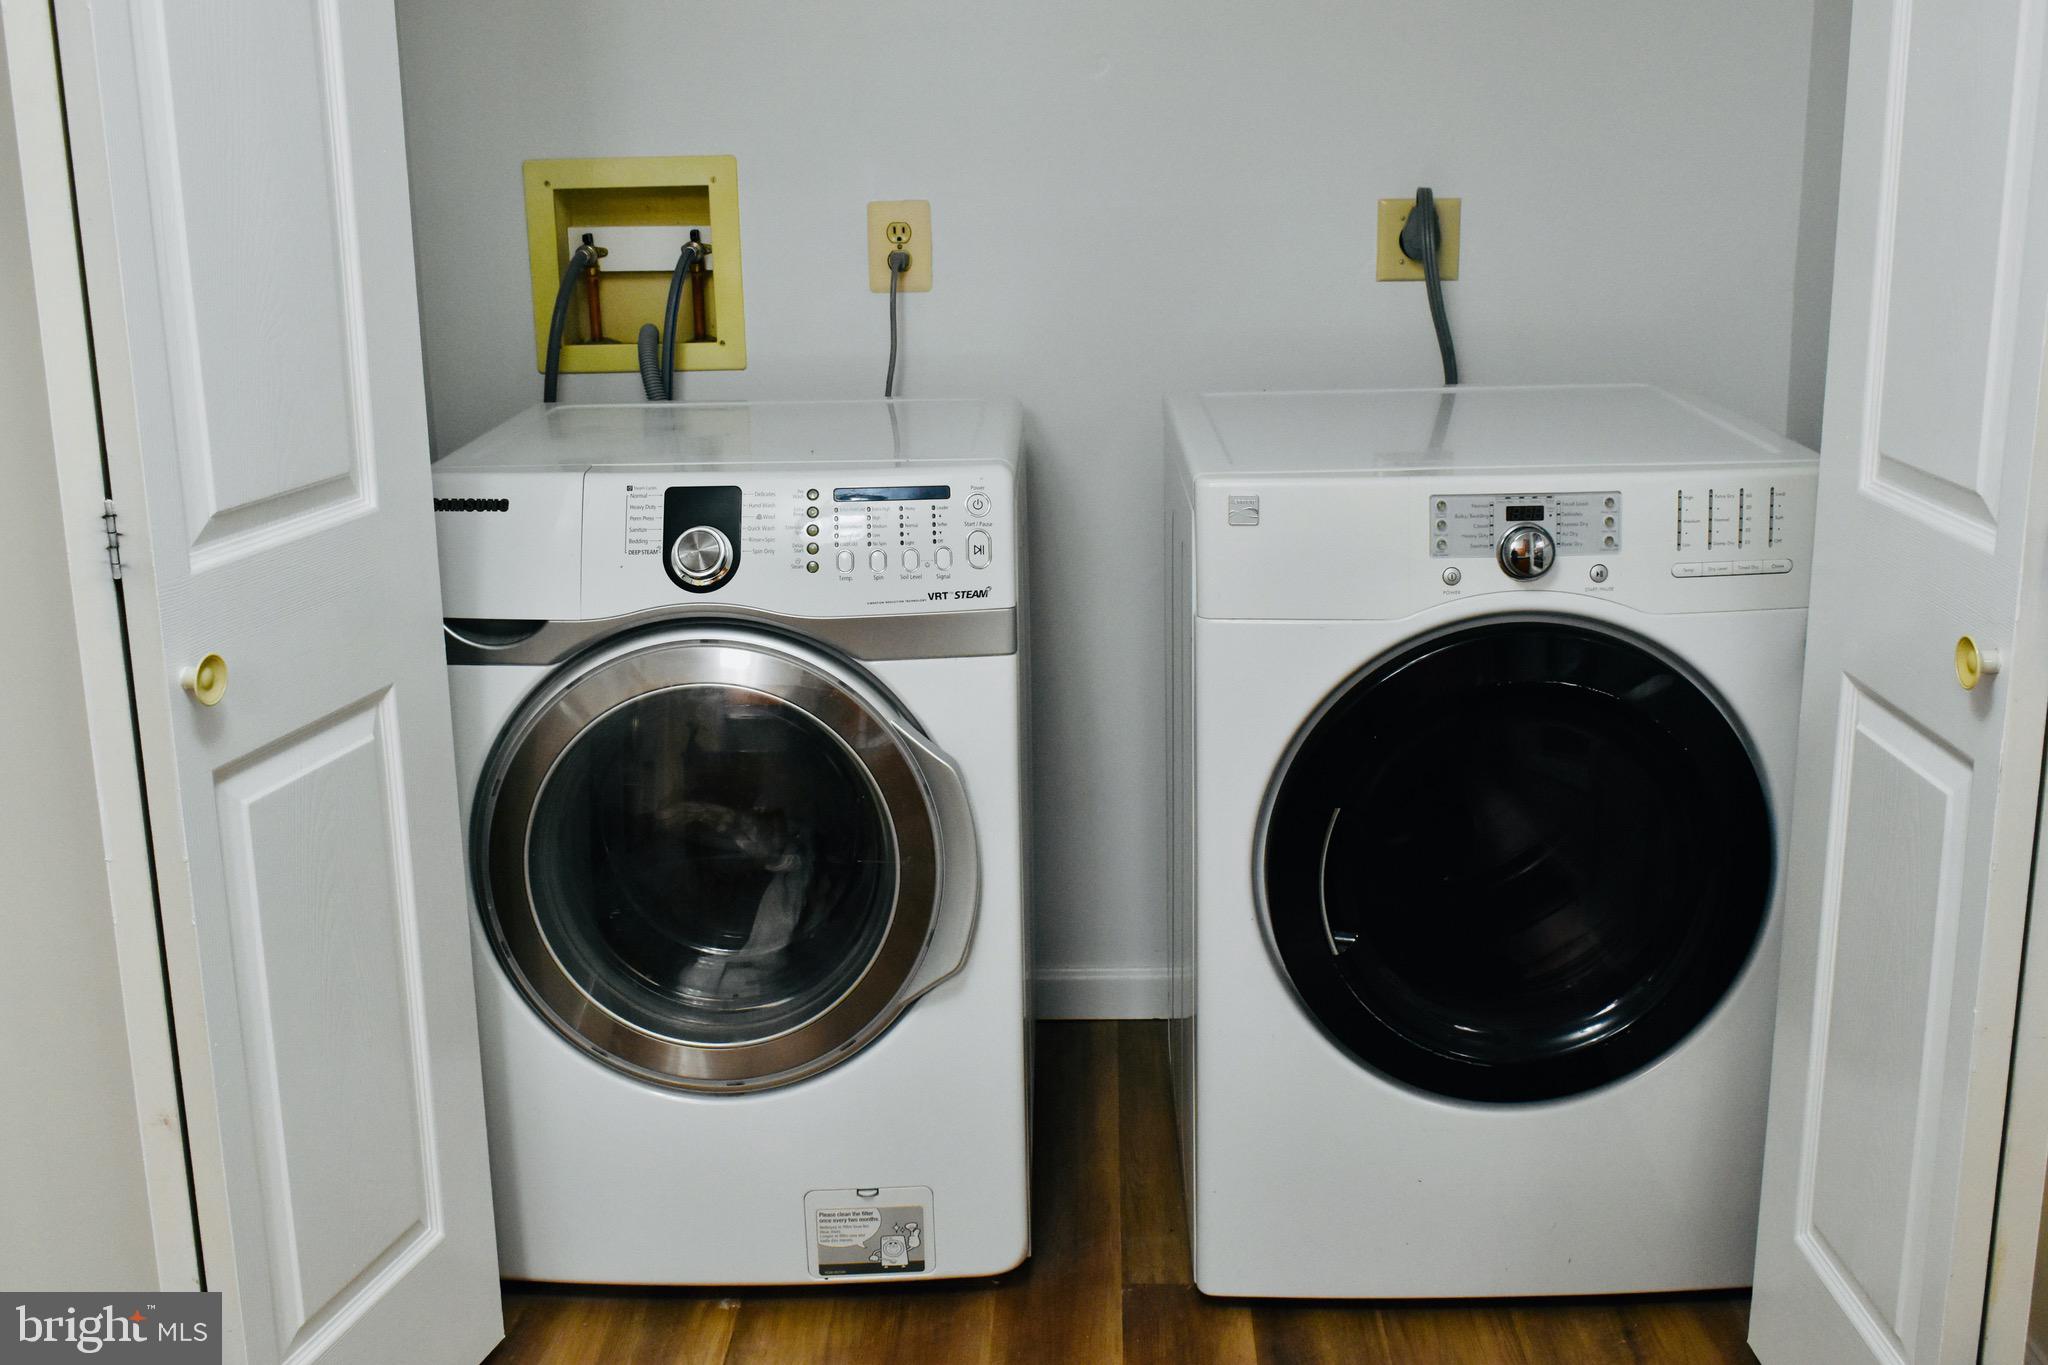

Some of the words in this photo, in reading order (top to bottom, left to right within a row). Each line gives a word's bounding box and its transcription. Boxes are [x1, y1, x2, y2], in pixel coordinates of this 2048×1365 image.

[936, 573, 951, 581] Signal
[927, 591, 949, 601] VRT
[954, 589, 989, 599] STEAM
